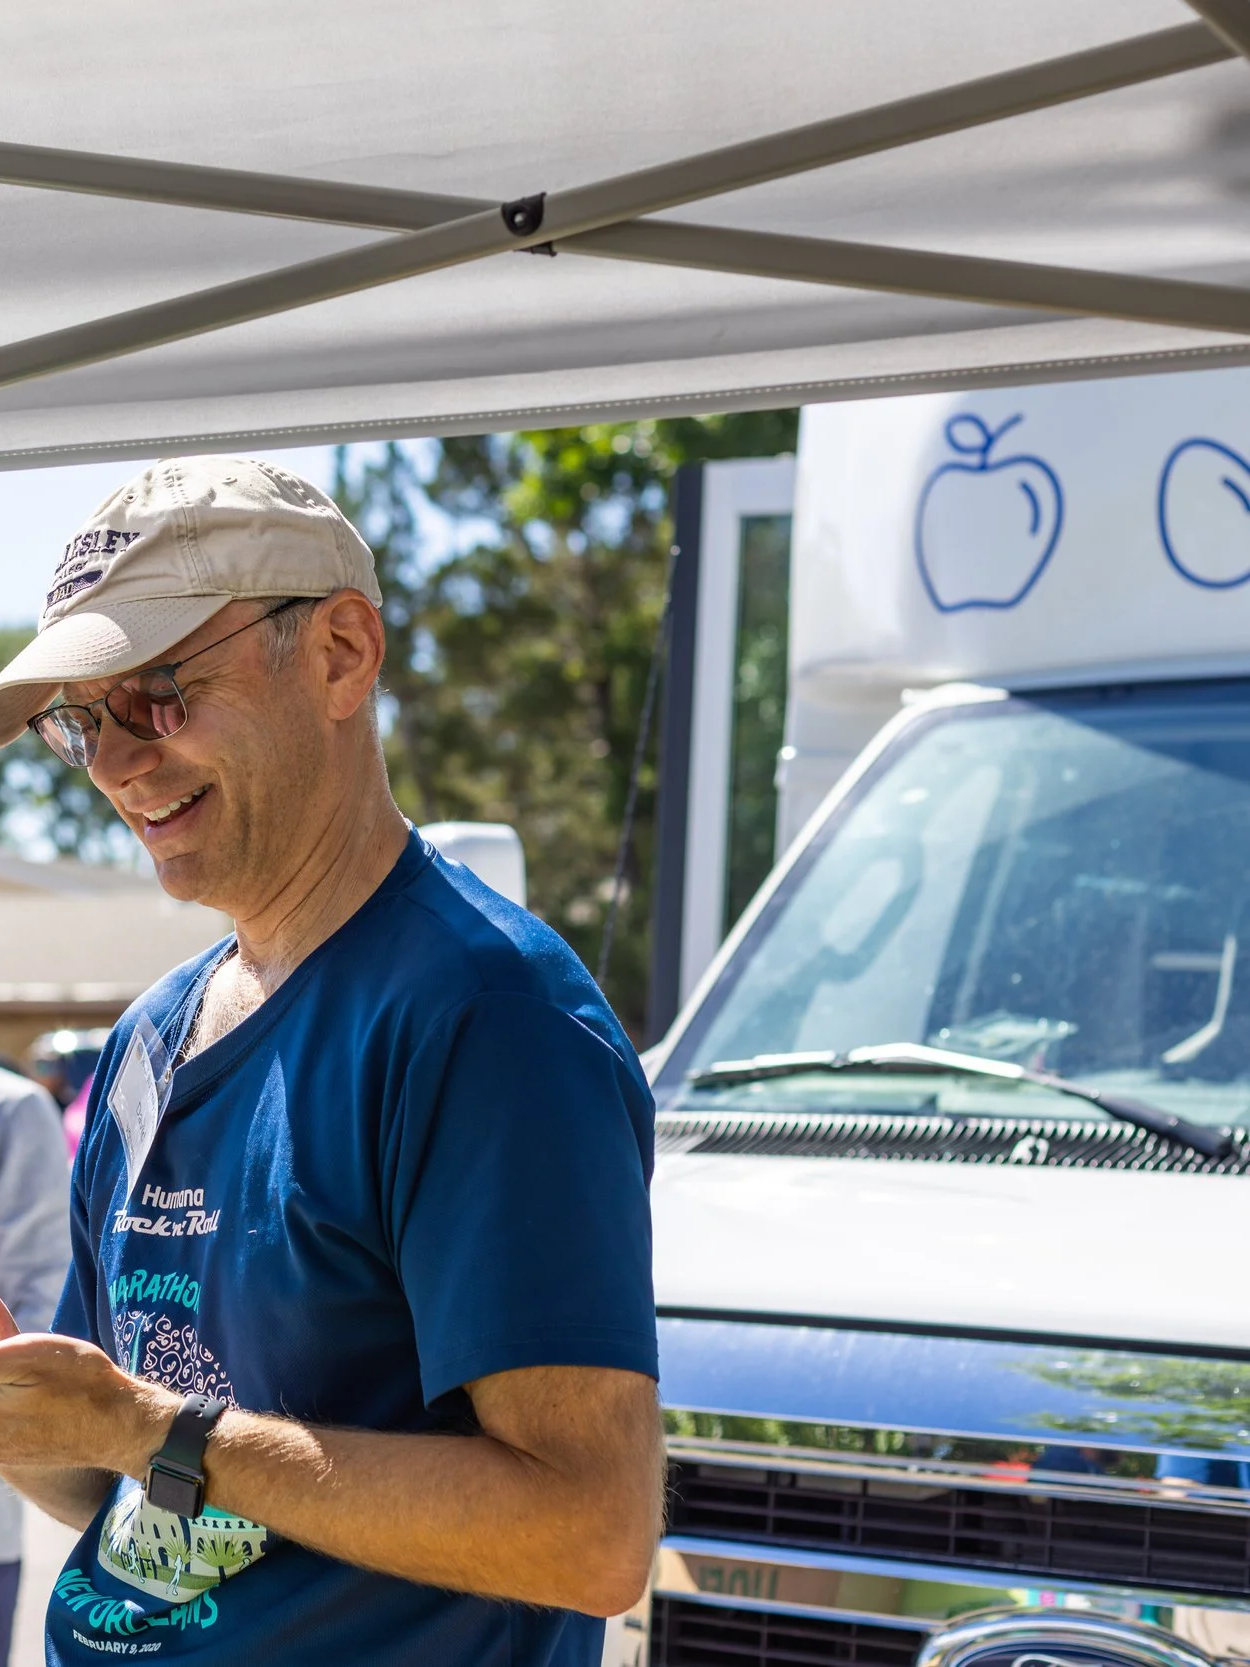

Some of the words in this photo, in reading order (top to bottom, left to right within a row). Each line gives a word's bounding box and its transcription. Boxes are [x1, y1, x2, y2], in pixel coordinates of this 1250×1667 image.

[54, 529, 141, 575] LESLEY
[141, 1183, 205, 1210] Humana
[54, 1568, 112, 1613] NEW
[72, 1628, 129, 1655] FEBRUARY
[139, 1642, 162, 1654] 2020
